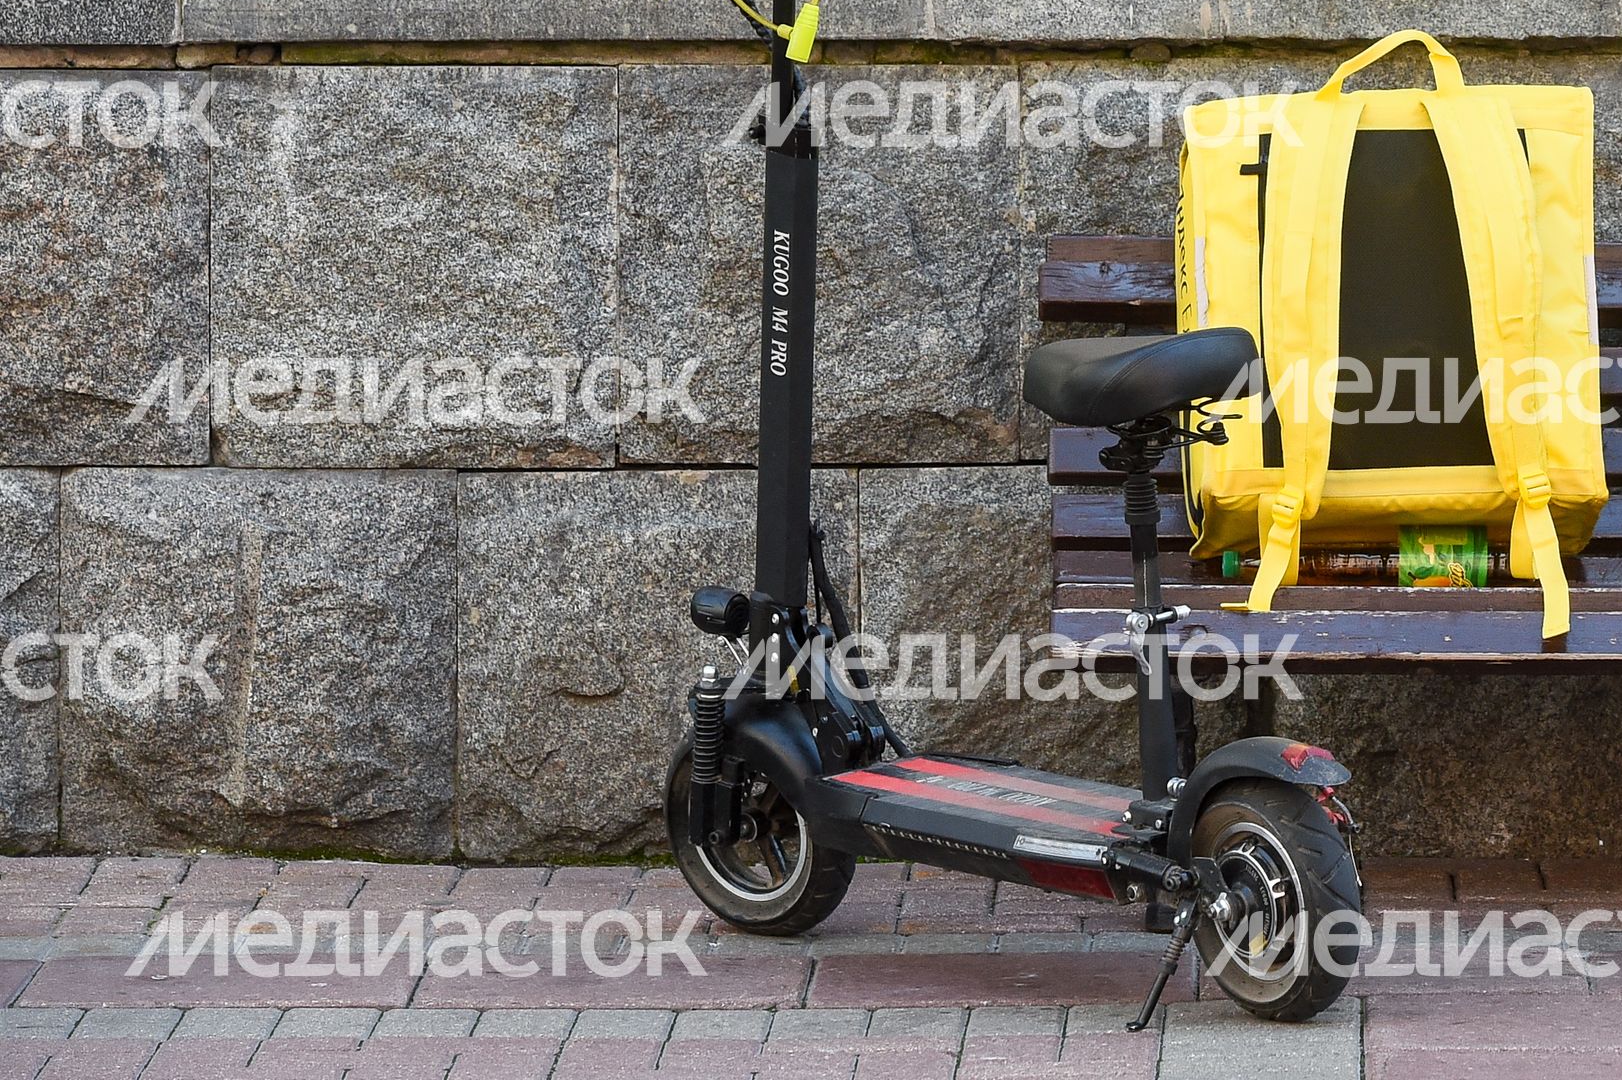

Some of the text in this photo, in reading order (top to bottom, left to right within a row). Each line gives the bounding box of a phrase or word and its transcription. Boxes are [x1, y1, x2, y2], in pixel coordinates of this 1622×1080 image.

[769, 229, 791, 377] KUGOO M4 PRO
